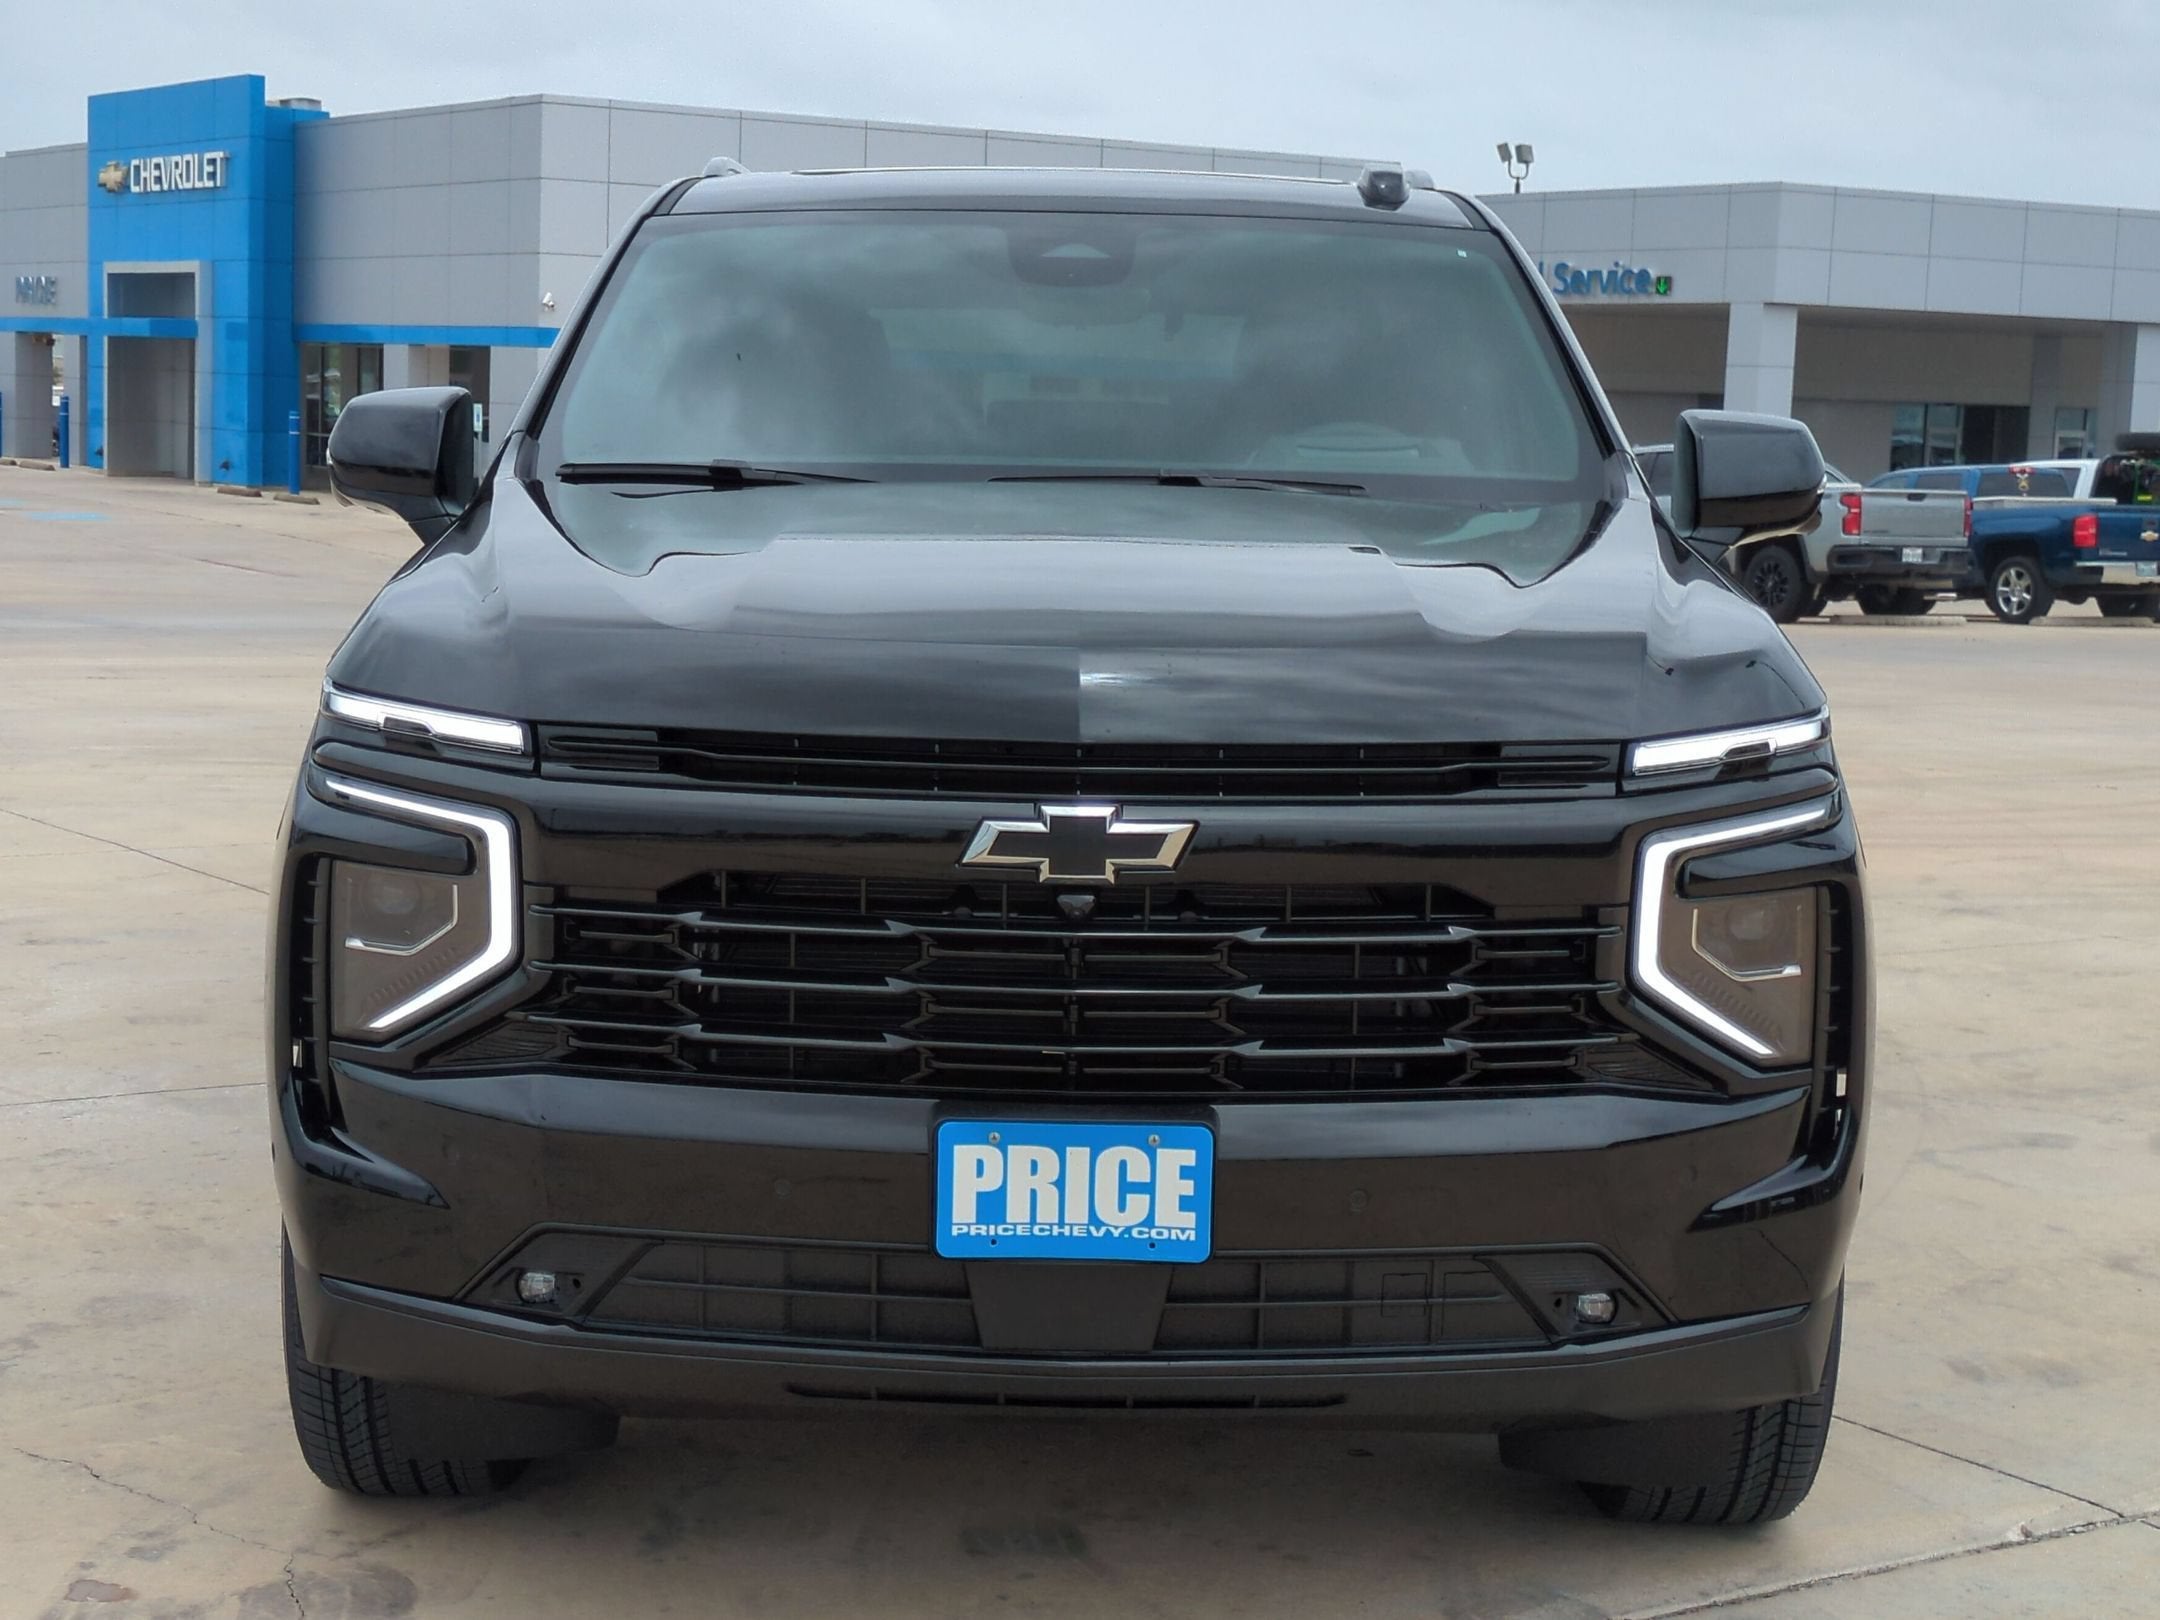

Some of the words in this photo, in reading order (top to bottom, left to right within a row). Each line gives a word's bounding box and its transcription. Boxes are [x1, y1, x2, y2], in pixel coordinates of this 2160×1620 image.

[130, 151, 225, 193] CHEVROLET
[1553, 260, 1653, 295] Service
[952, 1144, 1197, 1228] PRICE
[951, 1223, 1197, 1241] PRICECHEVY.COM
